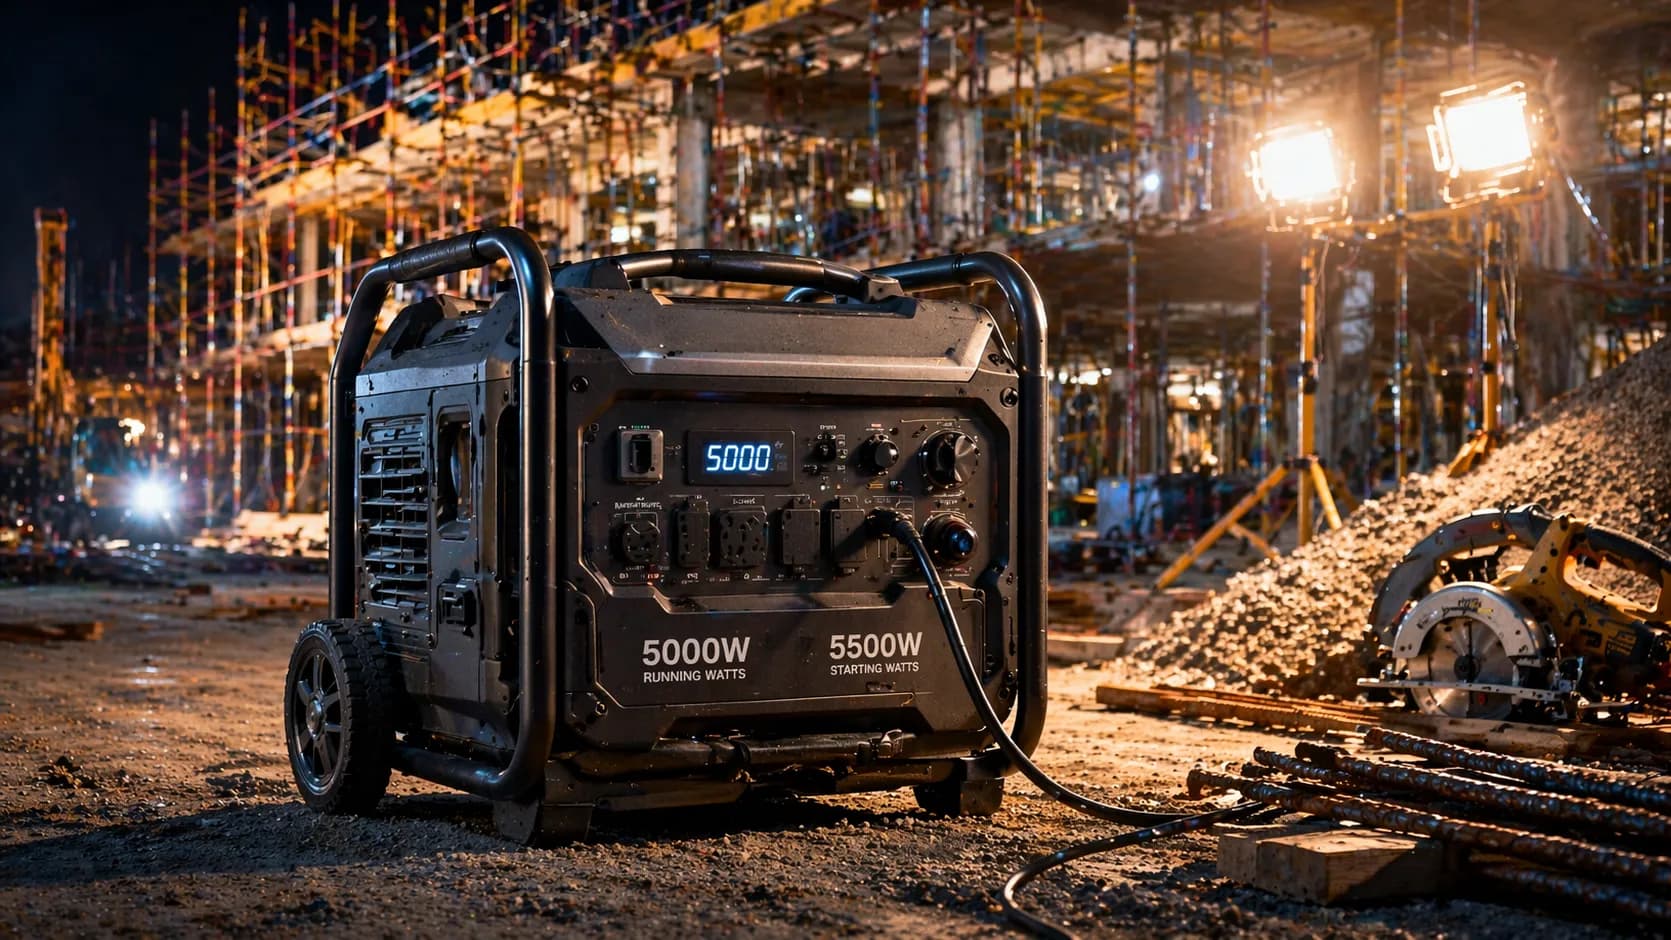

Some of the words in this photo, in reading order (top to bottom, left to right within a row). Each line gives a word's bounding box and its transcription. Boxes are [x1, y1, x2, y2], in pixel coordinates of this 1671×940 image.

[706, 444, 771, 472] 5000
[642, 637, 751, 666] 5000W
[829, 632, 923, 660] 5500W
[643, 670, 702, 683] RUNNING
[705, 668, 746, 681] WATTS
[830, 664, 883, 676] STARTING
[885, 661, 920, 674] WATTS
